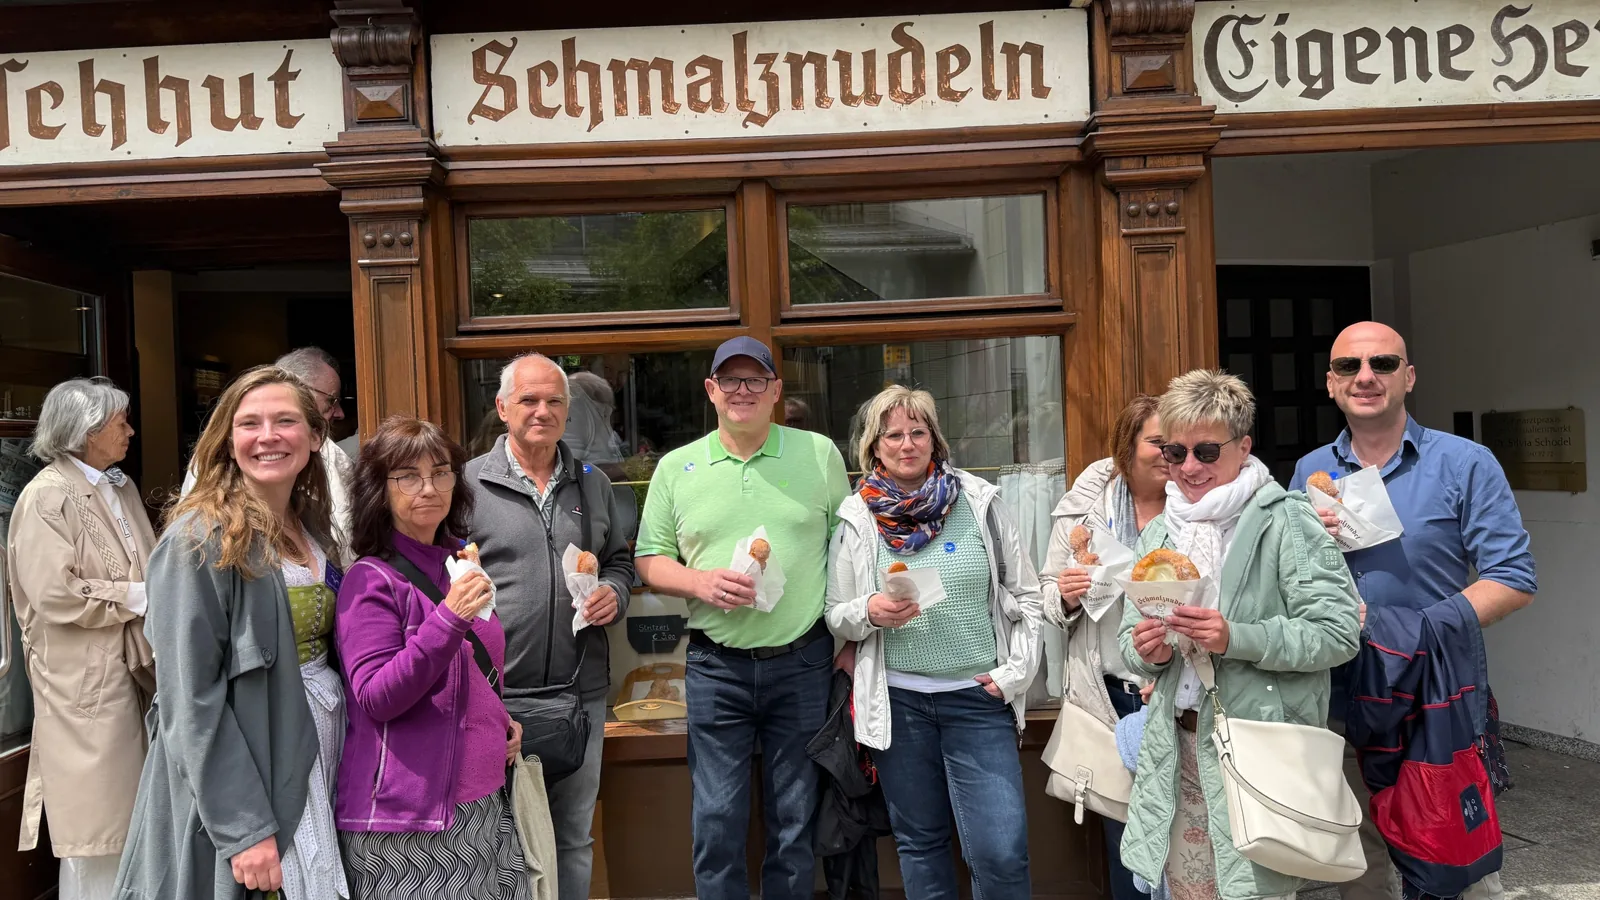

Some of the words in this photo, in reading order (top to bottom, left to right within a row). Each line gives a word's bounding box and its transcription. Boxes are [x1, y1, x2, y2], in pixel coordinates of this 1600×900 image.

[466, 20, 1053, 132] Schmalznudeln
[1203, 12, 1475, 103] Eigene
[1490, 4, 1600, 93] He
